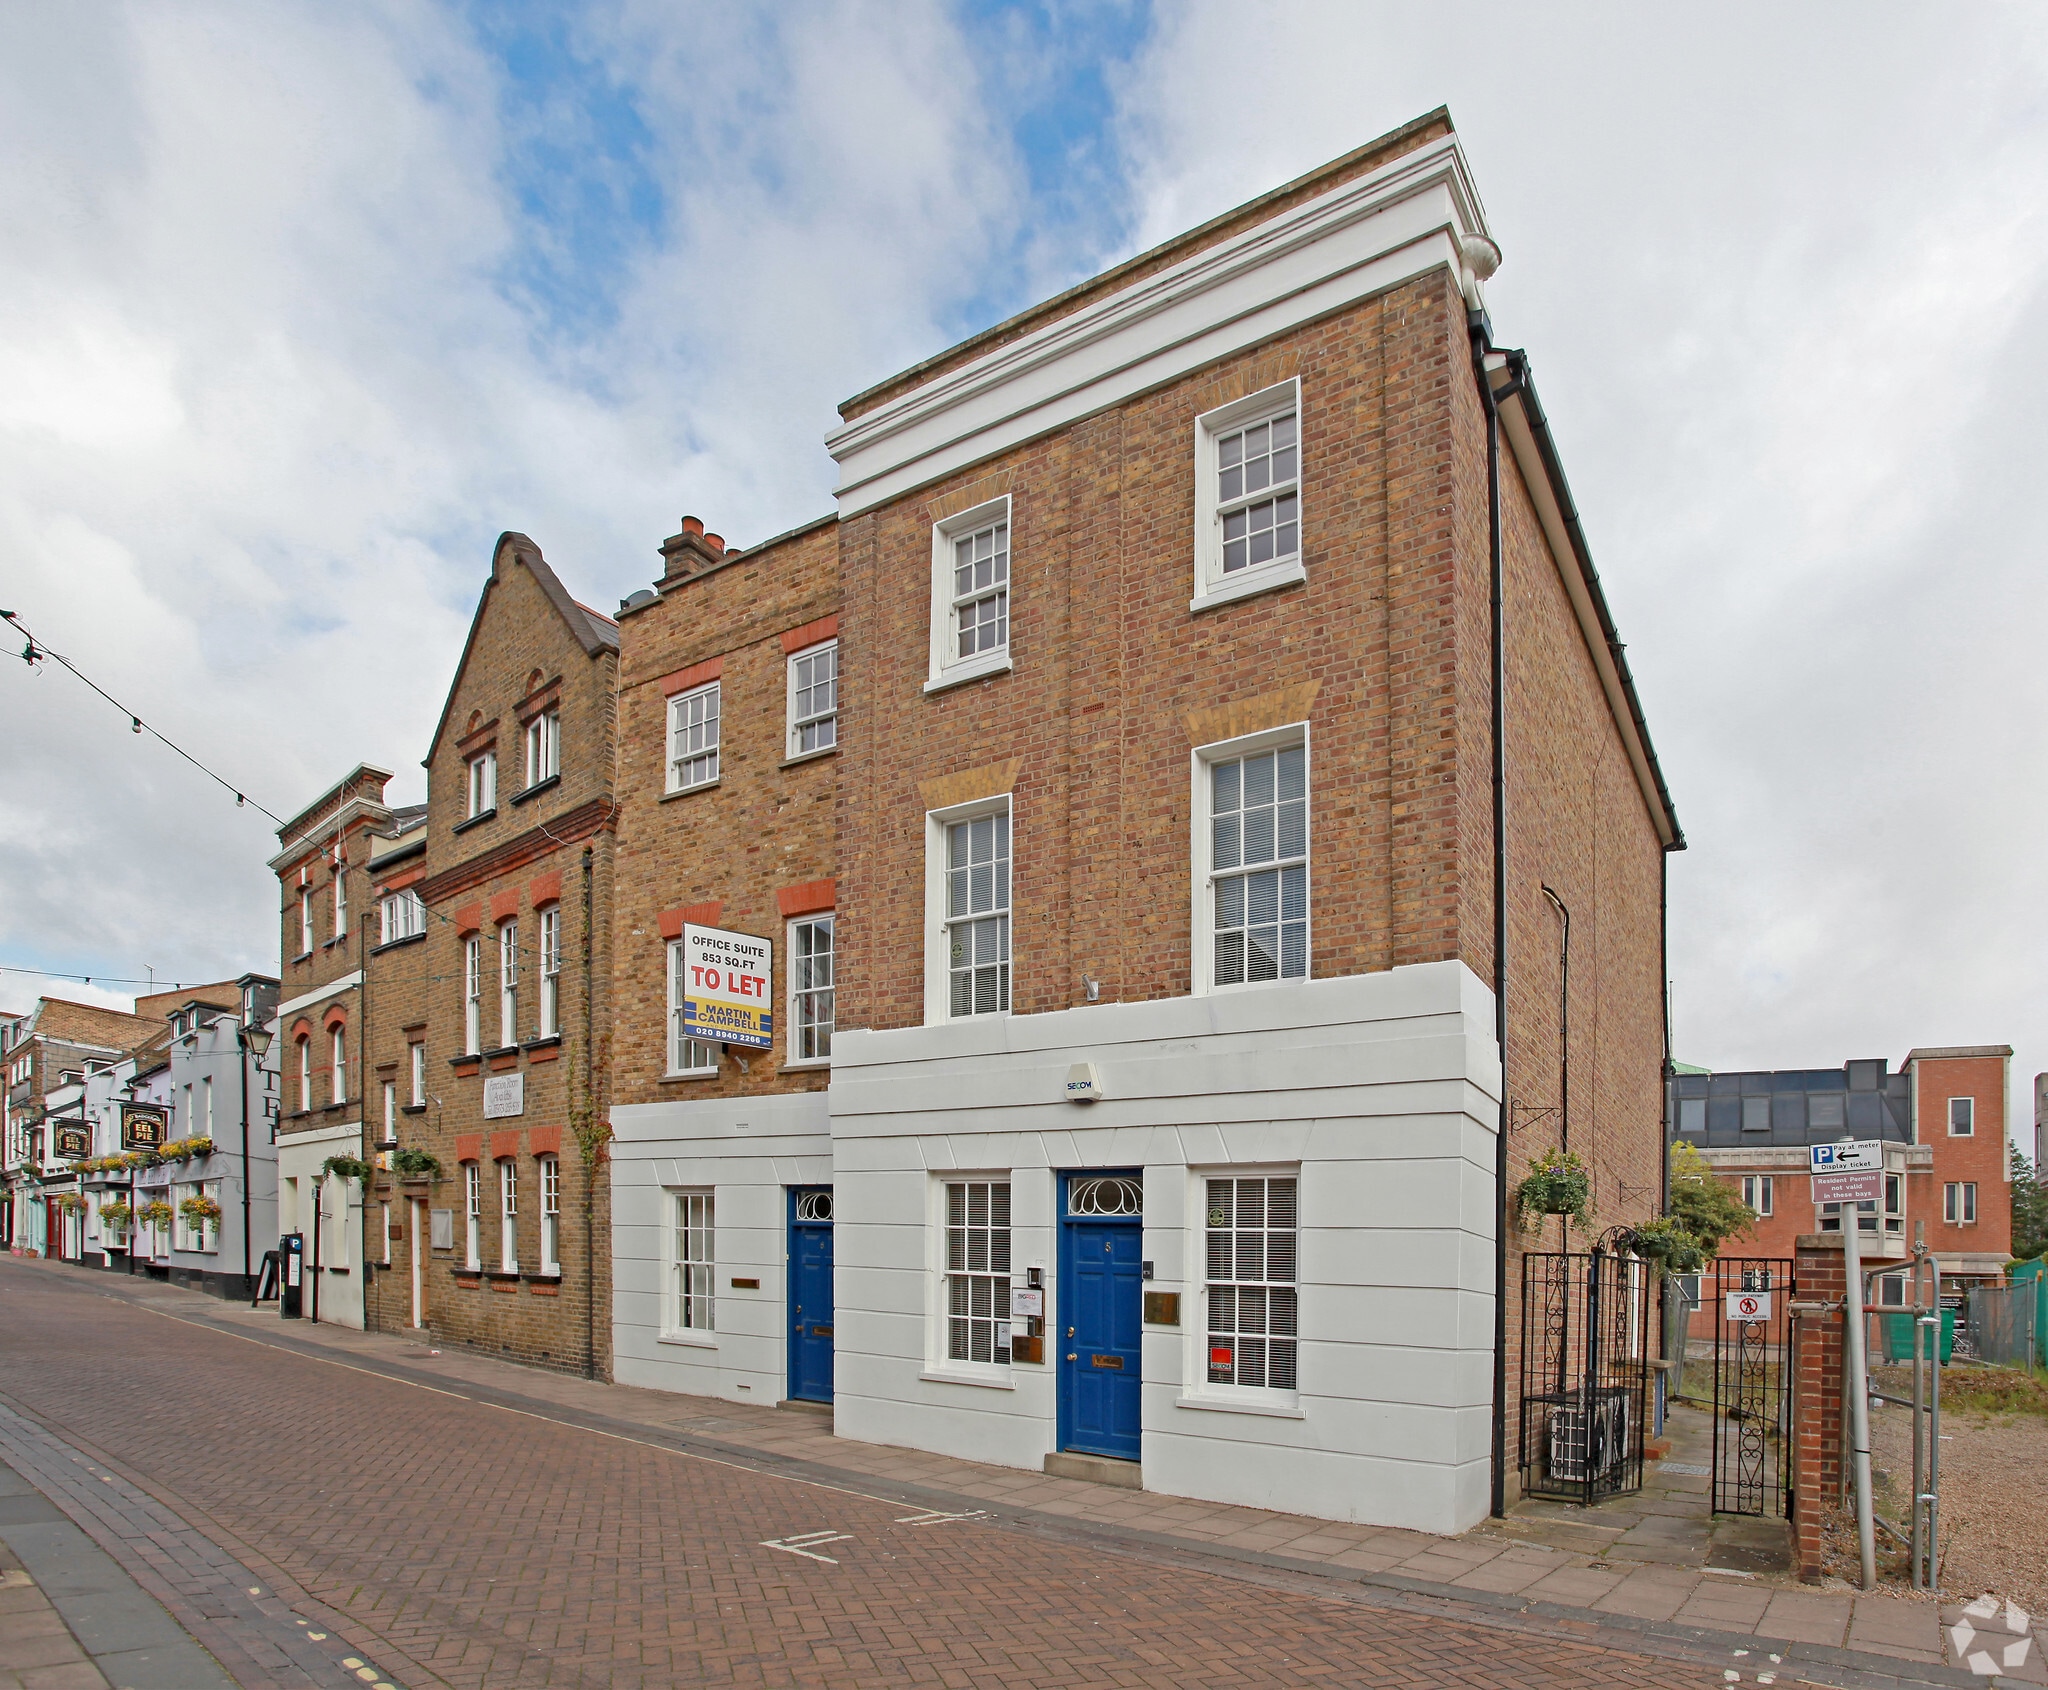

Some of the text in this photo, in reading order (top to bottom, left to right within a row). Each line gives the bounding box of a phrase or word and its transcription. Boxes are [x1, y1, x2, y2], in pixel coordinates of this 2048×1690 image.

[692, 935, 765, 958] OFFICE SUITE
[702, 952, 755, 970] 853 SQ.FT
[691, 965, 766, 998] TO LET
[706, 1004, 751, 1020] MARTIN
[698, 1012, 759, 1031] CAMPBELL
[696, 1027, 761, 1044] 020 8940 2266
[1067, 1081, 1092, 1090] SECOM
[135, 1124, 153, 1133] EEL
[136, 1132, 153, 1141] PIE
[1817, 1147, 1831, 1163] P
[1817, 1177, 1847, 1185] Resident
[292, 1239, 300, 1248] P
[1105, 1241, 1112, 1252] 5
